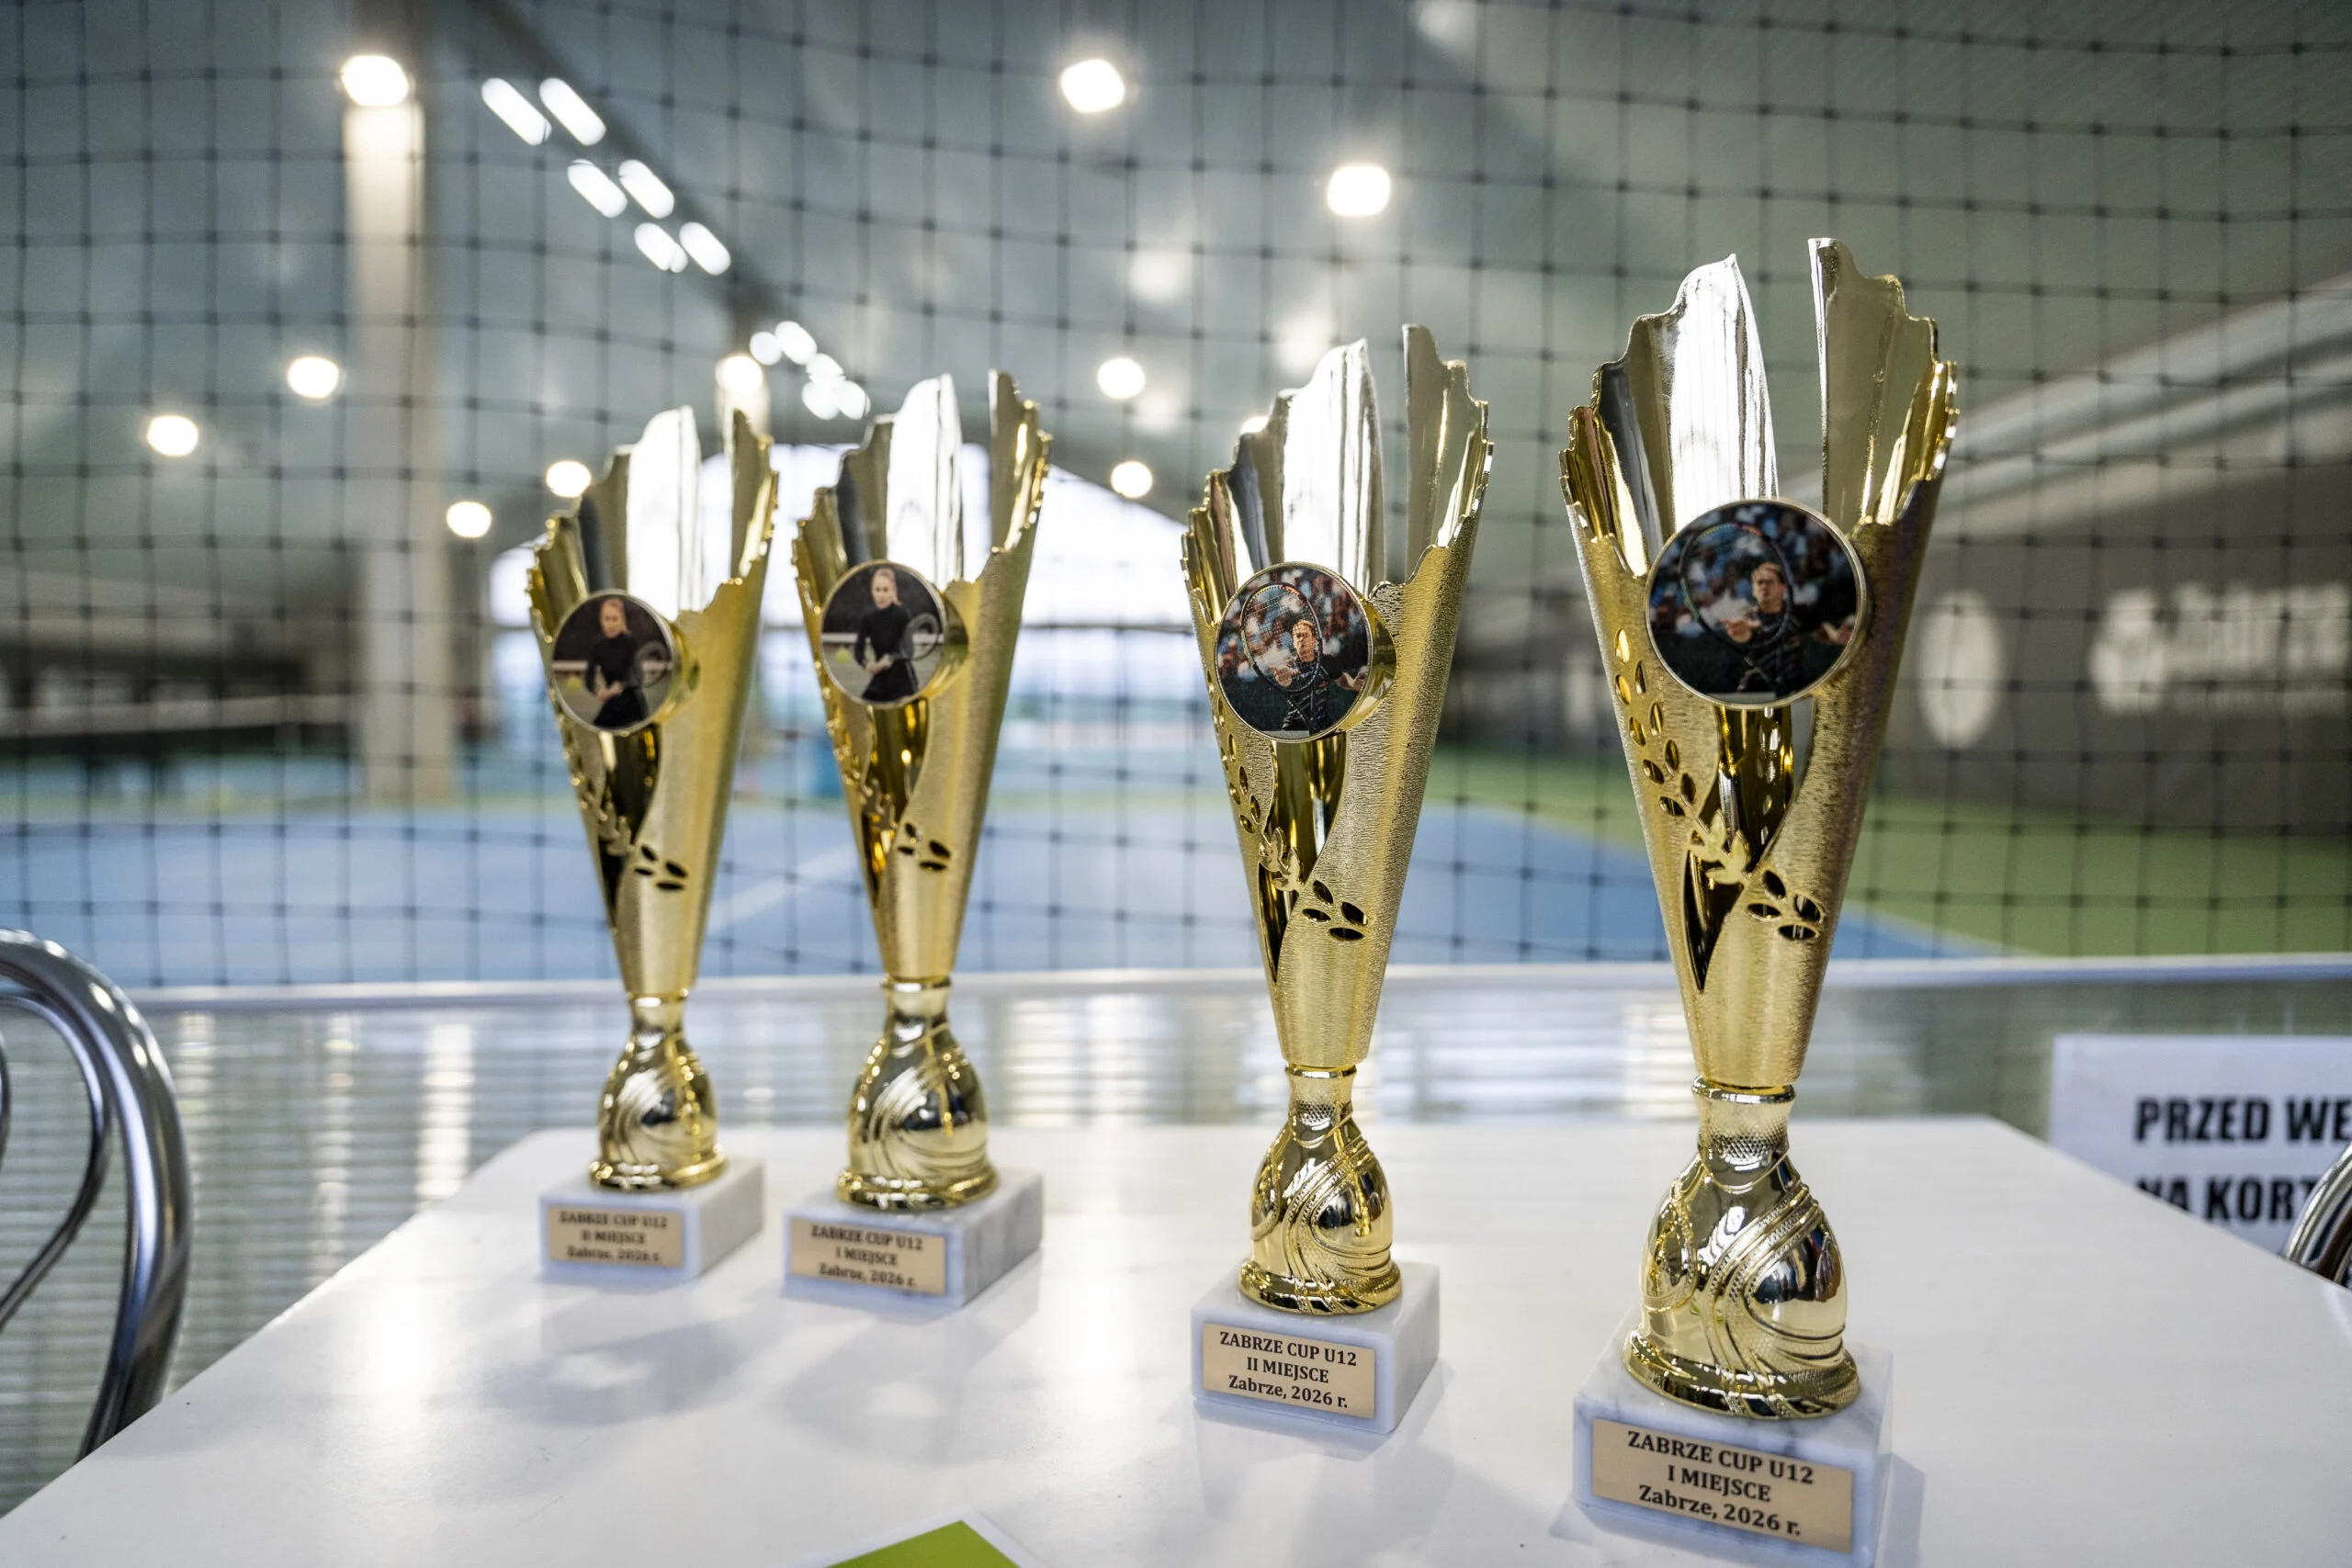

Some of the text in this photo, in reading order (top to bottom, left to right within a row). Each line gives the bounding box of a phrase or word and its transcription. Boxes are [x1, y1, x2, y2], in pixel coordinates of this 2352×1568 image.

[2134, 1096, 2270, 1143] PRZED
[614, 1214, 638, 1226] CUP
[811, 1224, 922, 1250] ZABRZE CUP U12
[836, 1247, 899, 1266] I MIEJSCE
[819, 1262, 866, 1282] Zabrze,
[869, 1269, 904, 1286] 2026
[1219, 1331, 1357, 1367] ZABRZE CUP U12
[1247, 1357, 1329, 1383] II MIEJSCE
[1228, 1375, 1348, 1408] Zabrze, 2026 r.
[1627, 1431, 1814, 1484] ZABRZE CUP U12
[1668, 1465, 1771, 1503] I MIEJSCE
[1638, 1484, 1801, 1536] Zabrze, 2026 r.
